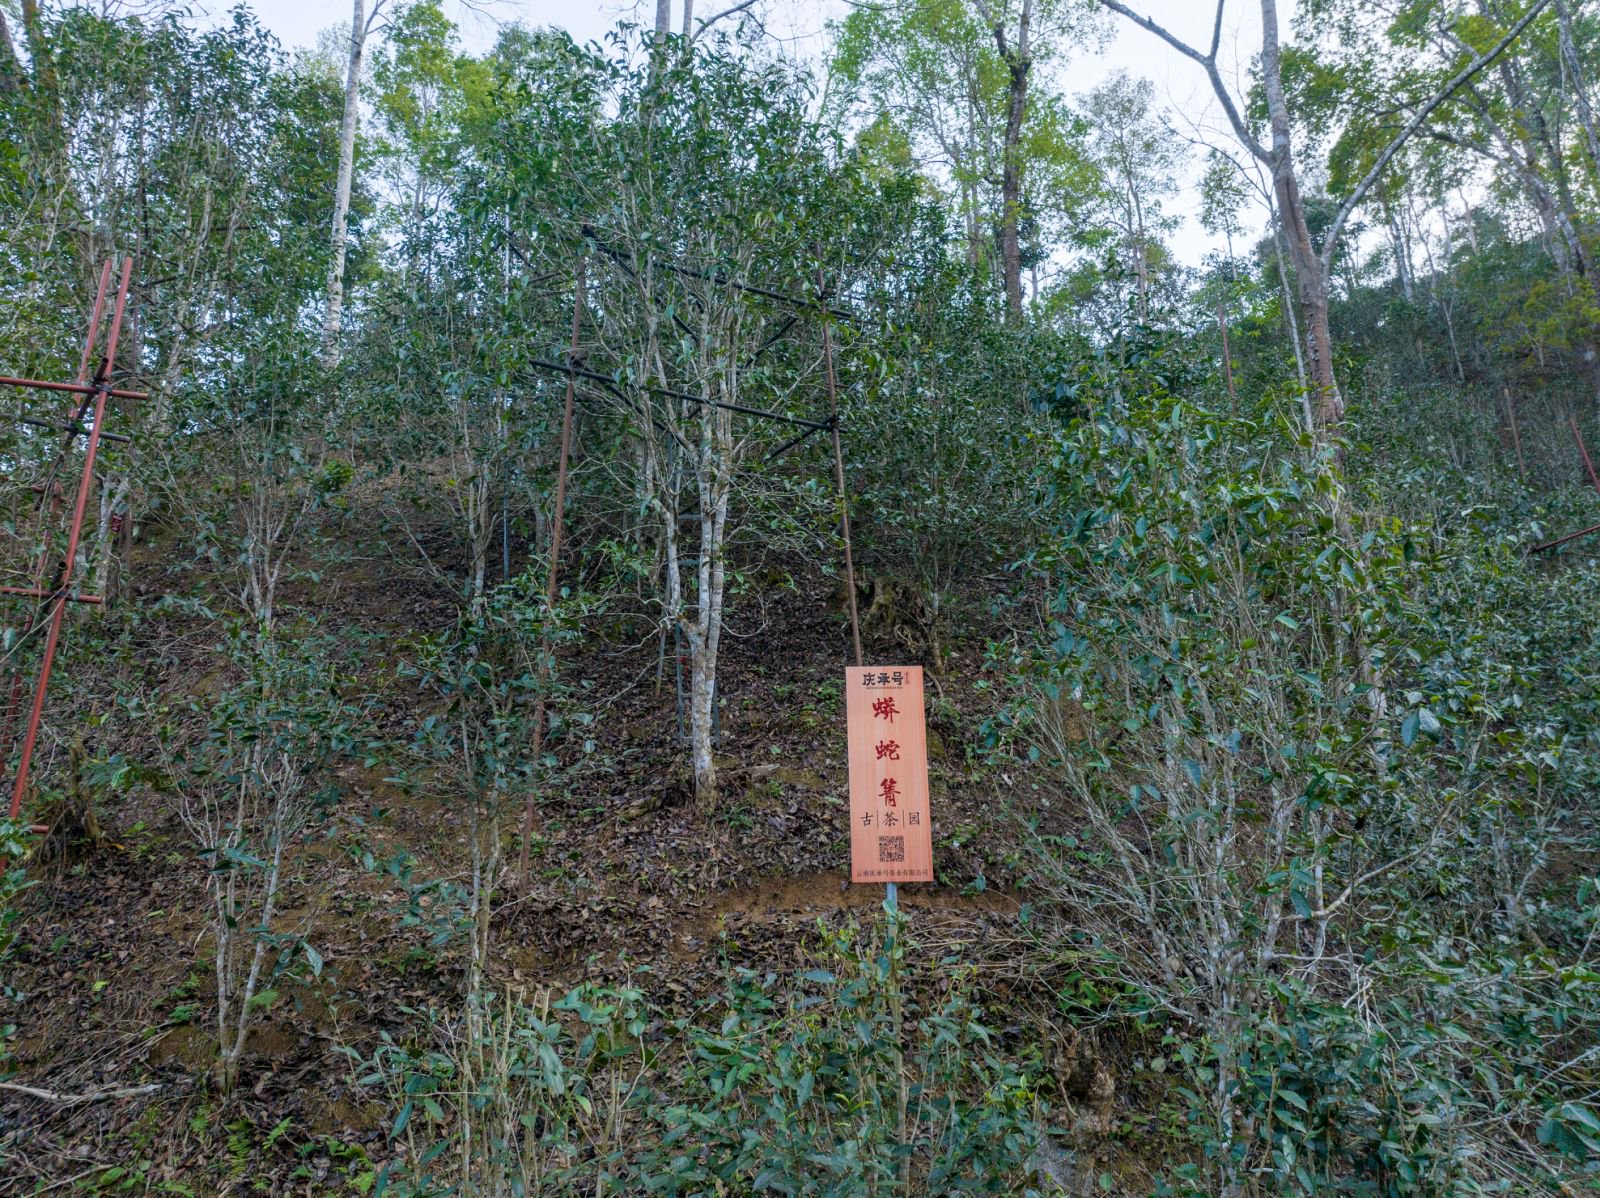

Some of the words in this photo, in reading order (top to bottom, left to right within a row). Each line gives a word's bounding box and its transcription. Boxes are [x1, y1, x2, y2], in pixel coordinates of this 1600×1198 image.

[862, 671, 903, 686] 庆承号
[872, 697, 901, 807] 蟒蛇箐
